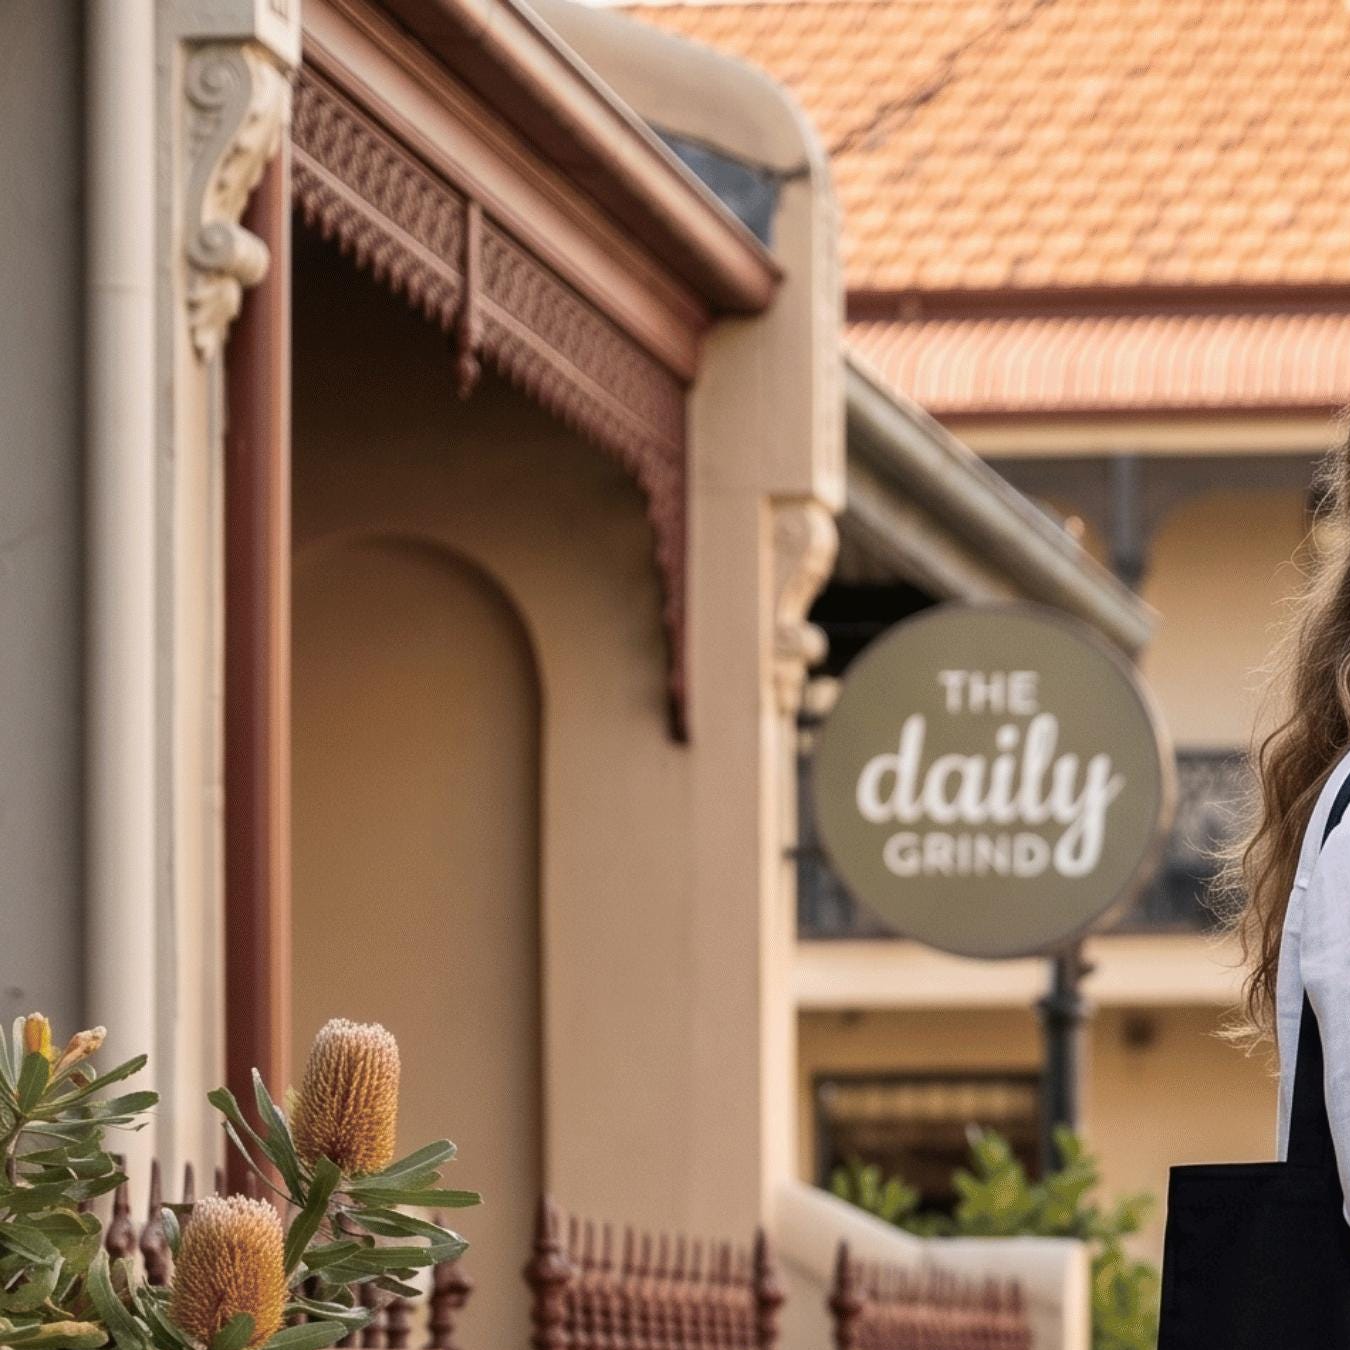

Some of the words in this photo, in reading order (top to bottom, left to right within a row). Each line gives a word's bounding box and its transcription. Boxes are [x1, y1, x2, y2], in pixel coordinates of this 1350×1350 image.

[938, 669, 1040, 714] THE
[856, 713, 1126, 877] daily
[883, 832, 1051, 877] GRIND
